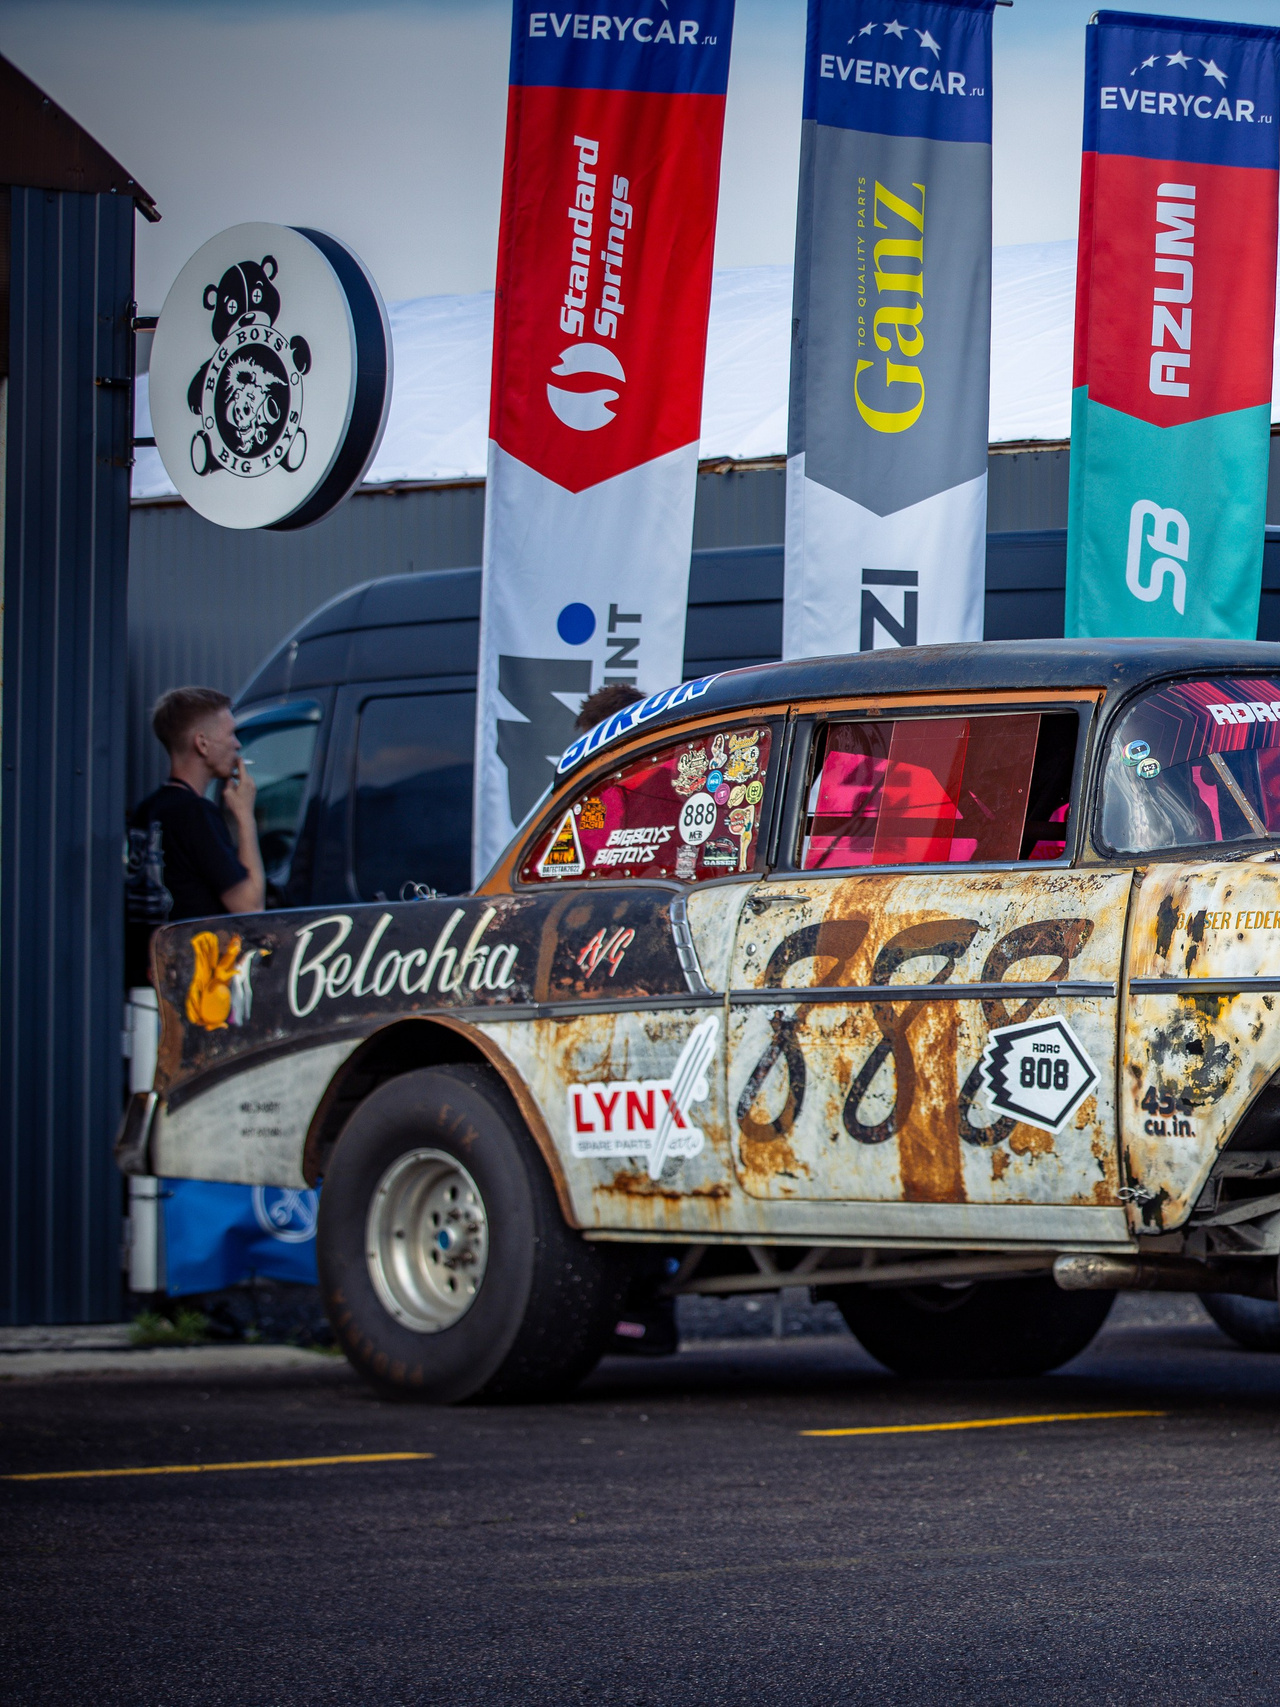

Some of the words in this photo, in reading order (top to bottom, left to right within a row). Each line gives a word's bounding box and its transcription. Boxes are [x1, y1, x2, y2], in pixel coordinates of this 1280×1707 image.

[858, 177, 866, 228] PARTS
[559, 134, 599, 337] Standard
[594, 174, 633, 339] Springs
[858, 236, 867, 307] QUALITY
[1149, 182, 1197, 398] AZUMI
[854, 180, 926, 434] Ganz
[858, 315, 866, 347] TOP
[205, 347, 229, 393] BIG
[218, 447, 252, 473] BIG
[261, 411, 300, 469] TOYS
[683, 802, 715, 827] 888
[287, 906, 520, 1018] Belochka
[1032, 1043, 1060, 1053] RDRC
[1020, 1056, 1069, 1091] 808
[573, 1089, 688, 1133] LYNX
[1144, 1115, 1196, 1138] cu.in.
[578, 1139, 613, 1152] SPARE
[615, 1138, 652, 1150] PARTS
